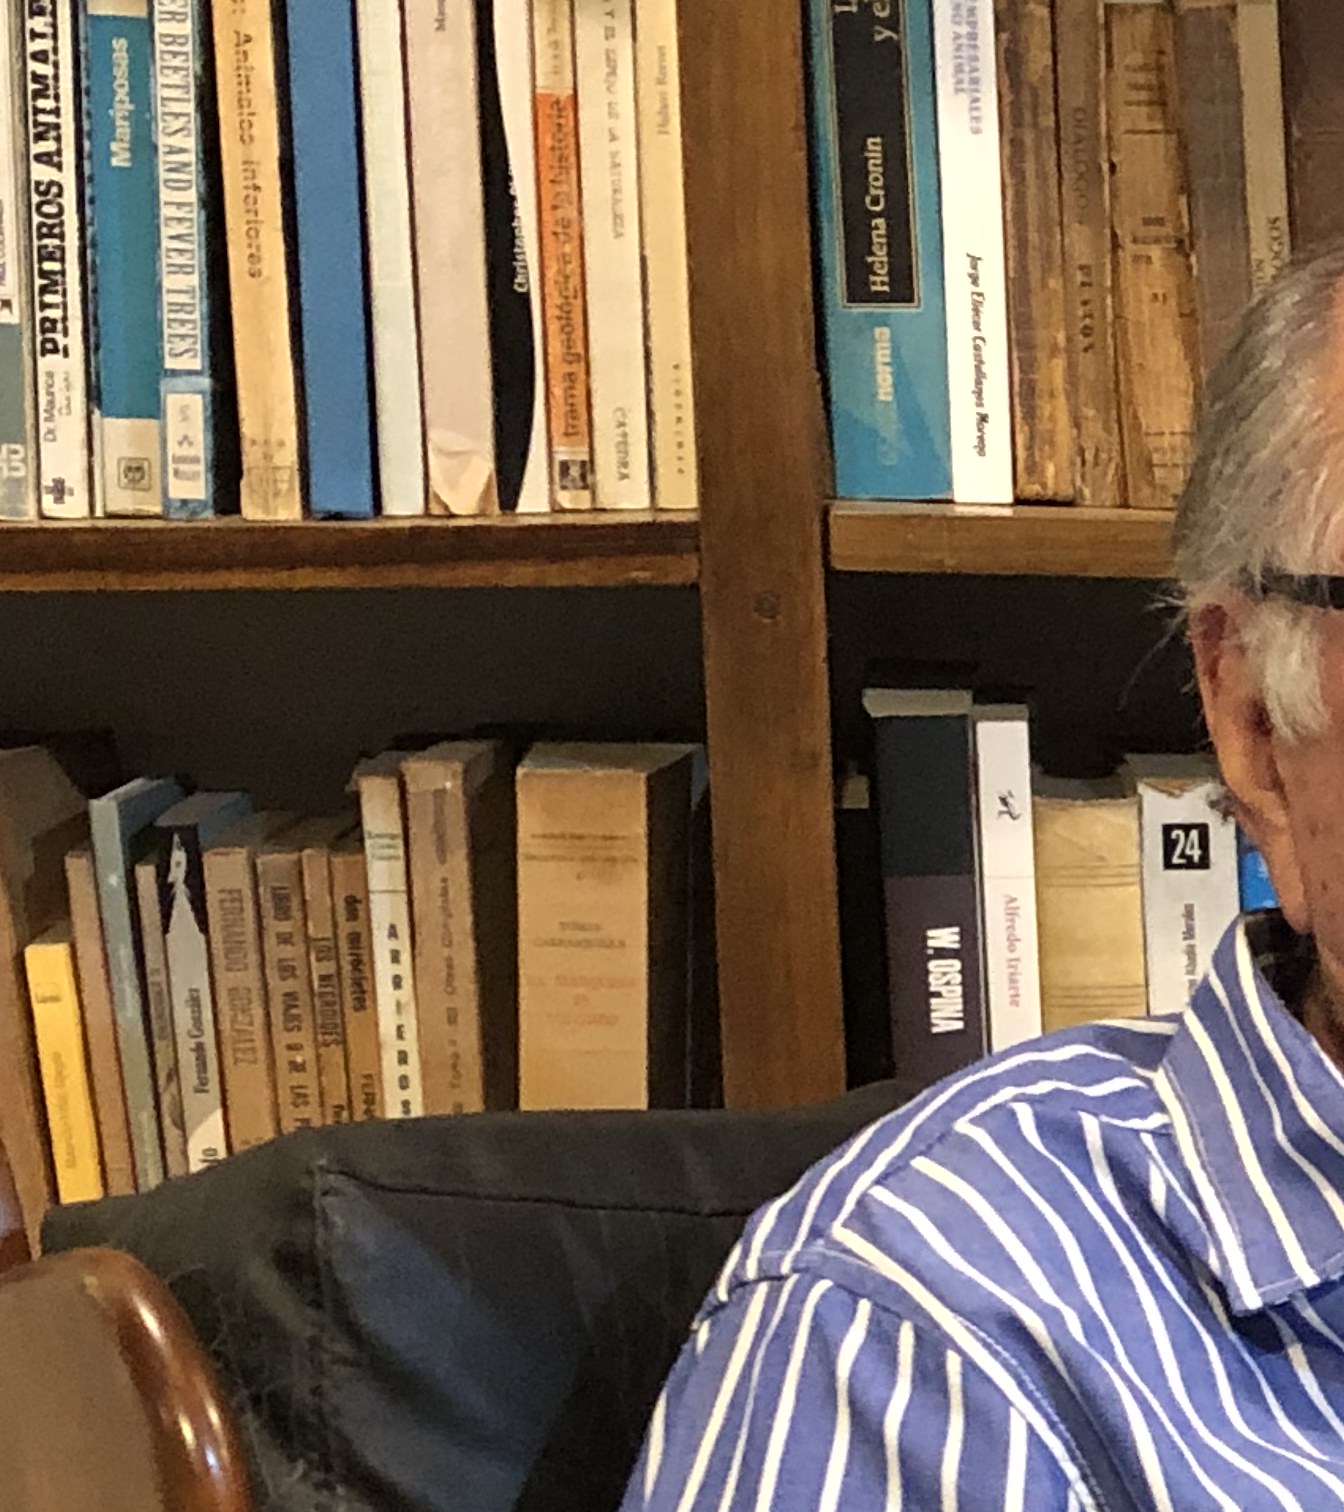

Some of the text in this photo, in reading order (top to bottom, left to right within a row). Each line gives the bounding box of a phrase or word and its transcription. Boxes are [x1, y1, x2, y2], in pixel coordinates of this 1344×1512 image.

[107, 36, 140, 168] Mariposas
[159, 32, 193, 138] BEETLES
[161, 143, 194, 192] AND
[162, 201, 196, 276] FEVER
[863, 135, 891, 293] Helena Cronin
[34, 179, 70, 359] PRIMEROS
[966, 252, 984, 288] Jorge
[165, 285, 199, 360] TREES
[873, 326, 895, 402] norma
[1169, 828, 1202, 865] 24
[925, 925, 966, 1035] W. OSPINA
[1003, 892, 1022, 1008] Alfredo Iriarte
